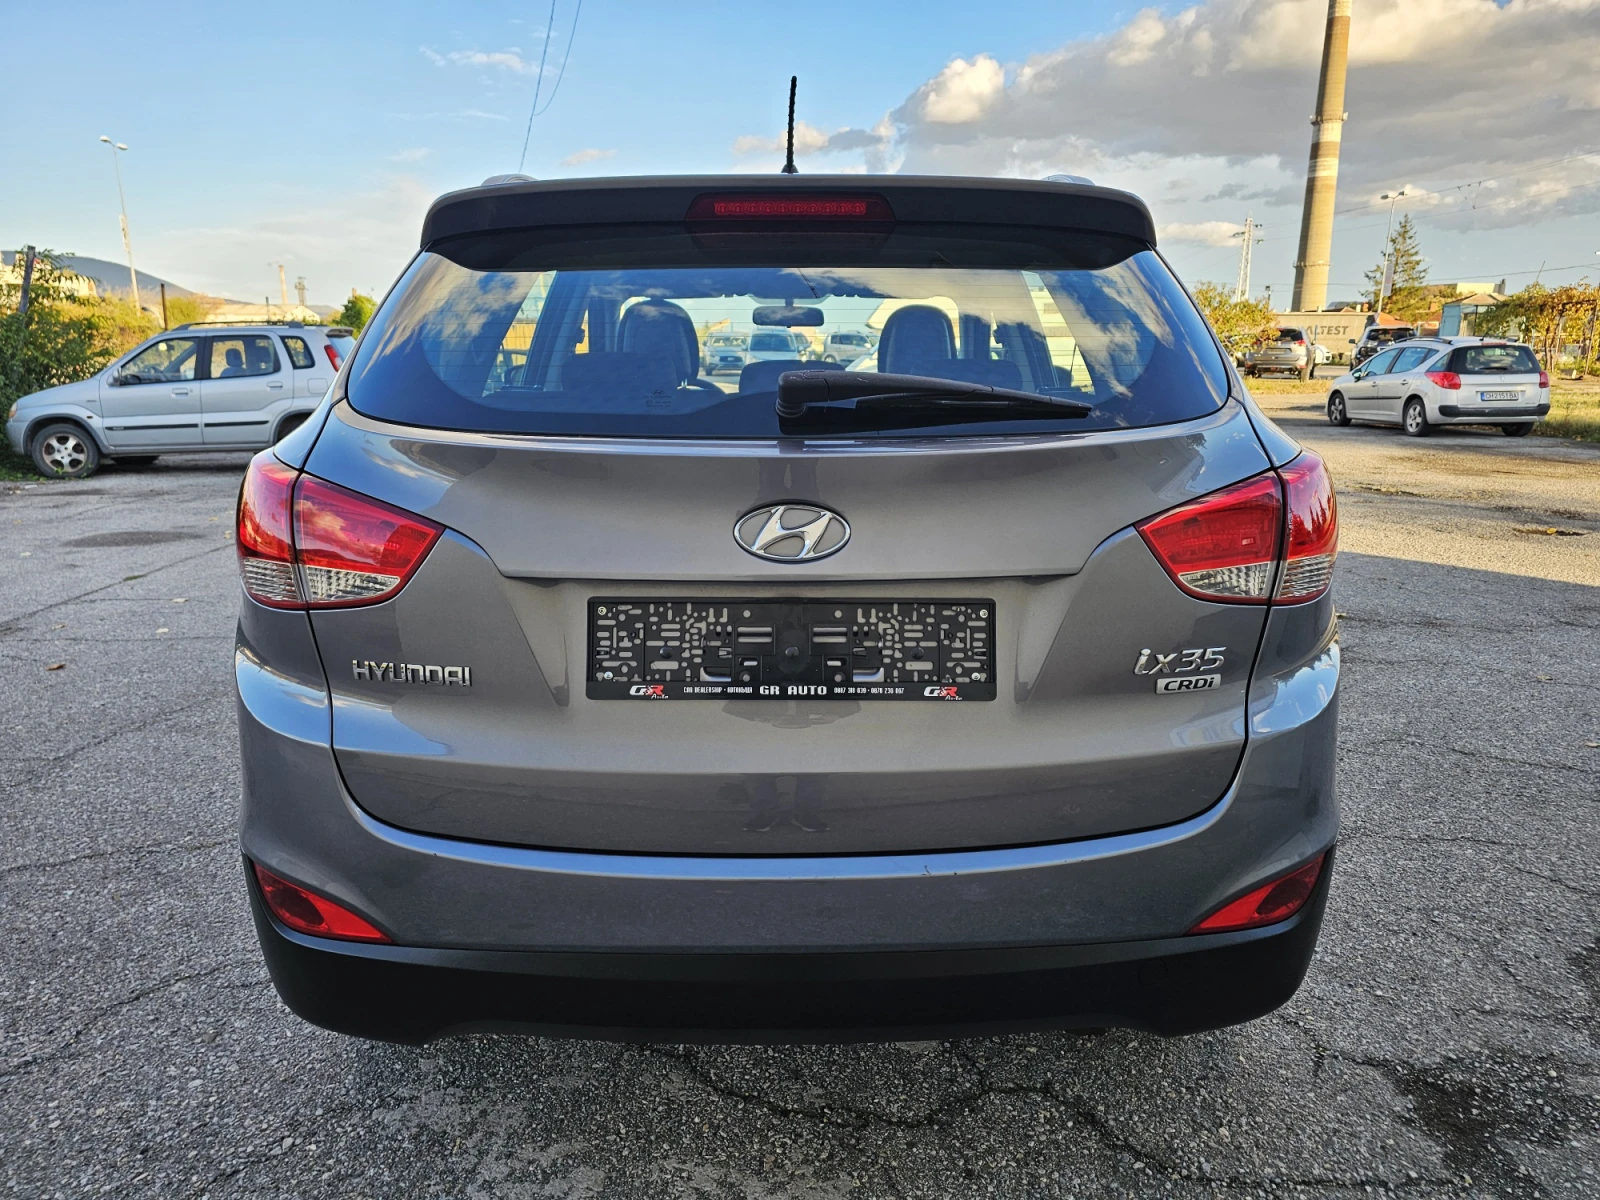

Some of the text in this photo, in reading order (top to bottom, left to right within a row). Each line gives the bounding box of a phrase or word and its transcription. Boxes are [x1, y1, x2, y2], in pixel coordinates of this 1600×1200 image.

[1133, 646, 1227, 675] ix35
[352, 659, 472, 687] HYUNDAI
[694, 686, 723, 694] DEALERSHIP
[759, 685, 828, 695] GR AUTO
[1163, 677, 1215, 691] CRDi
